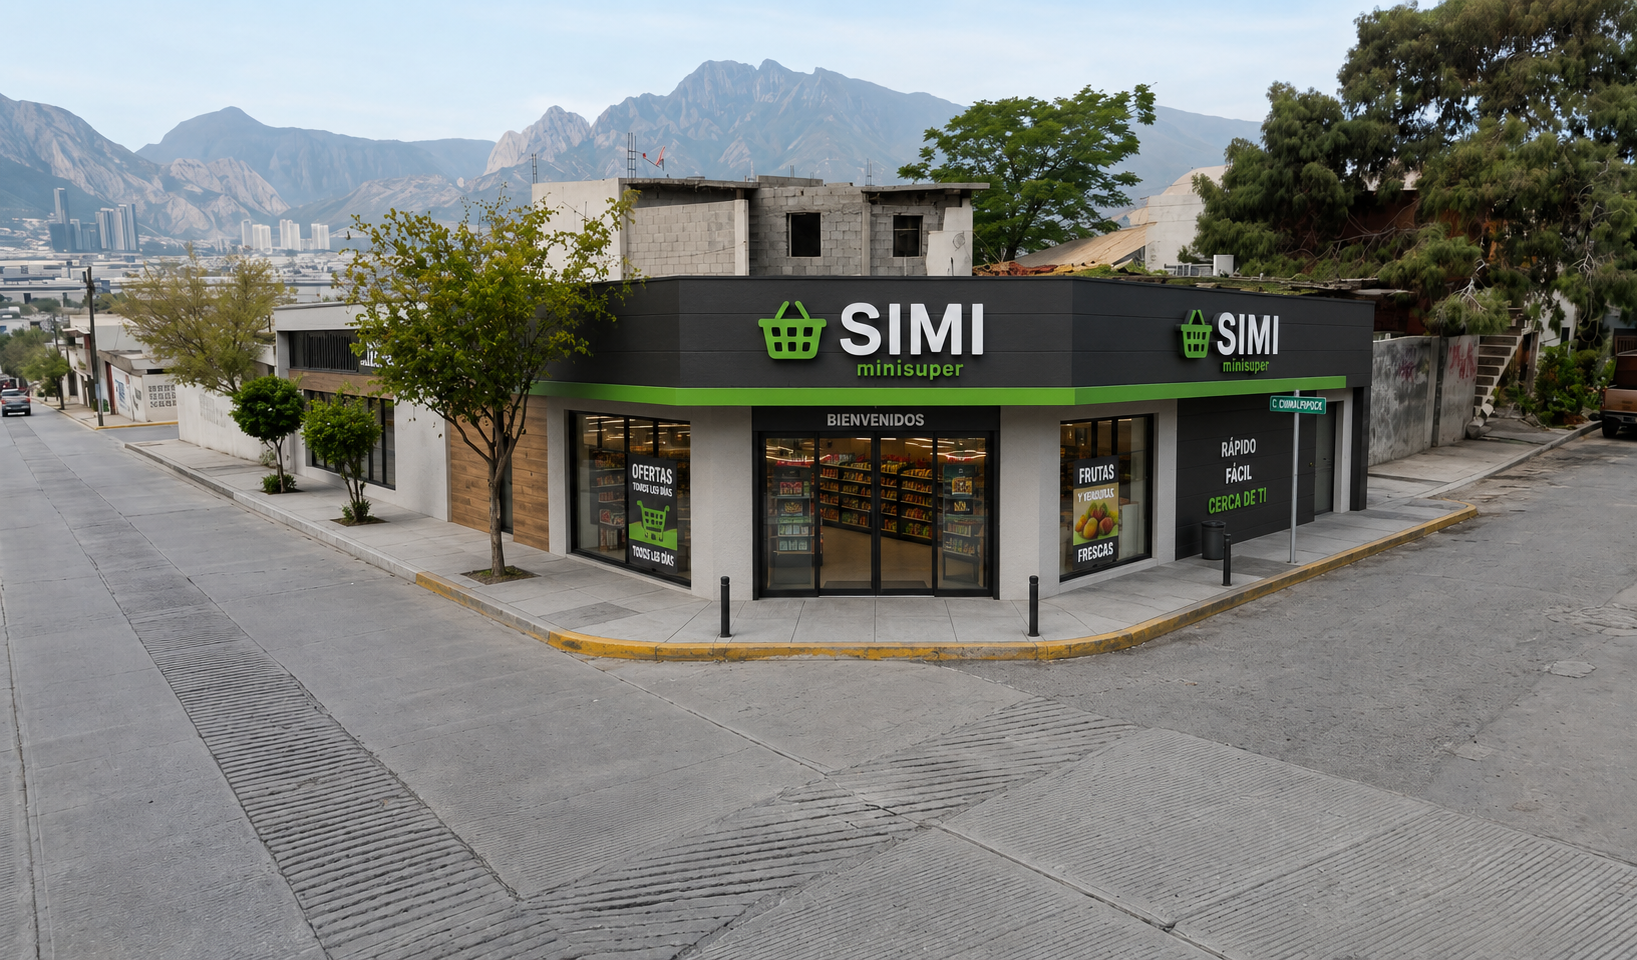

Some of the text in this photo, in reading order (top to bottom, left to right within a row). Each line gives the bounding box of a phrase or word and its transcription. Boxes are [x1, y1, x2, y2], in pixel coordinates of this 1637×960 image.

[839, 302, 984, 356] SIMI
[1217, 312, 1279, 356] SIMI
[857, 359, 964, 380] minisuper
[1222, 358, 1269, 374] minisuper
[827, 413, 925, 427] BIENVENIDOS
[1221, 436, 1257, 458] RÁPIDO
[632, 463, 673, 485] OFERTAS
[1079, 463, 1115, 484] FRUTAS
[1225, 462, 1252, 484] FÁCIL
[1077, 492, 1082, 503] Y
[1208, 487, 1267, 514] CERCA DE TI
[1077, 541, 1114, 563] FRESCAS
